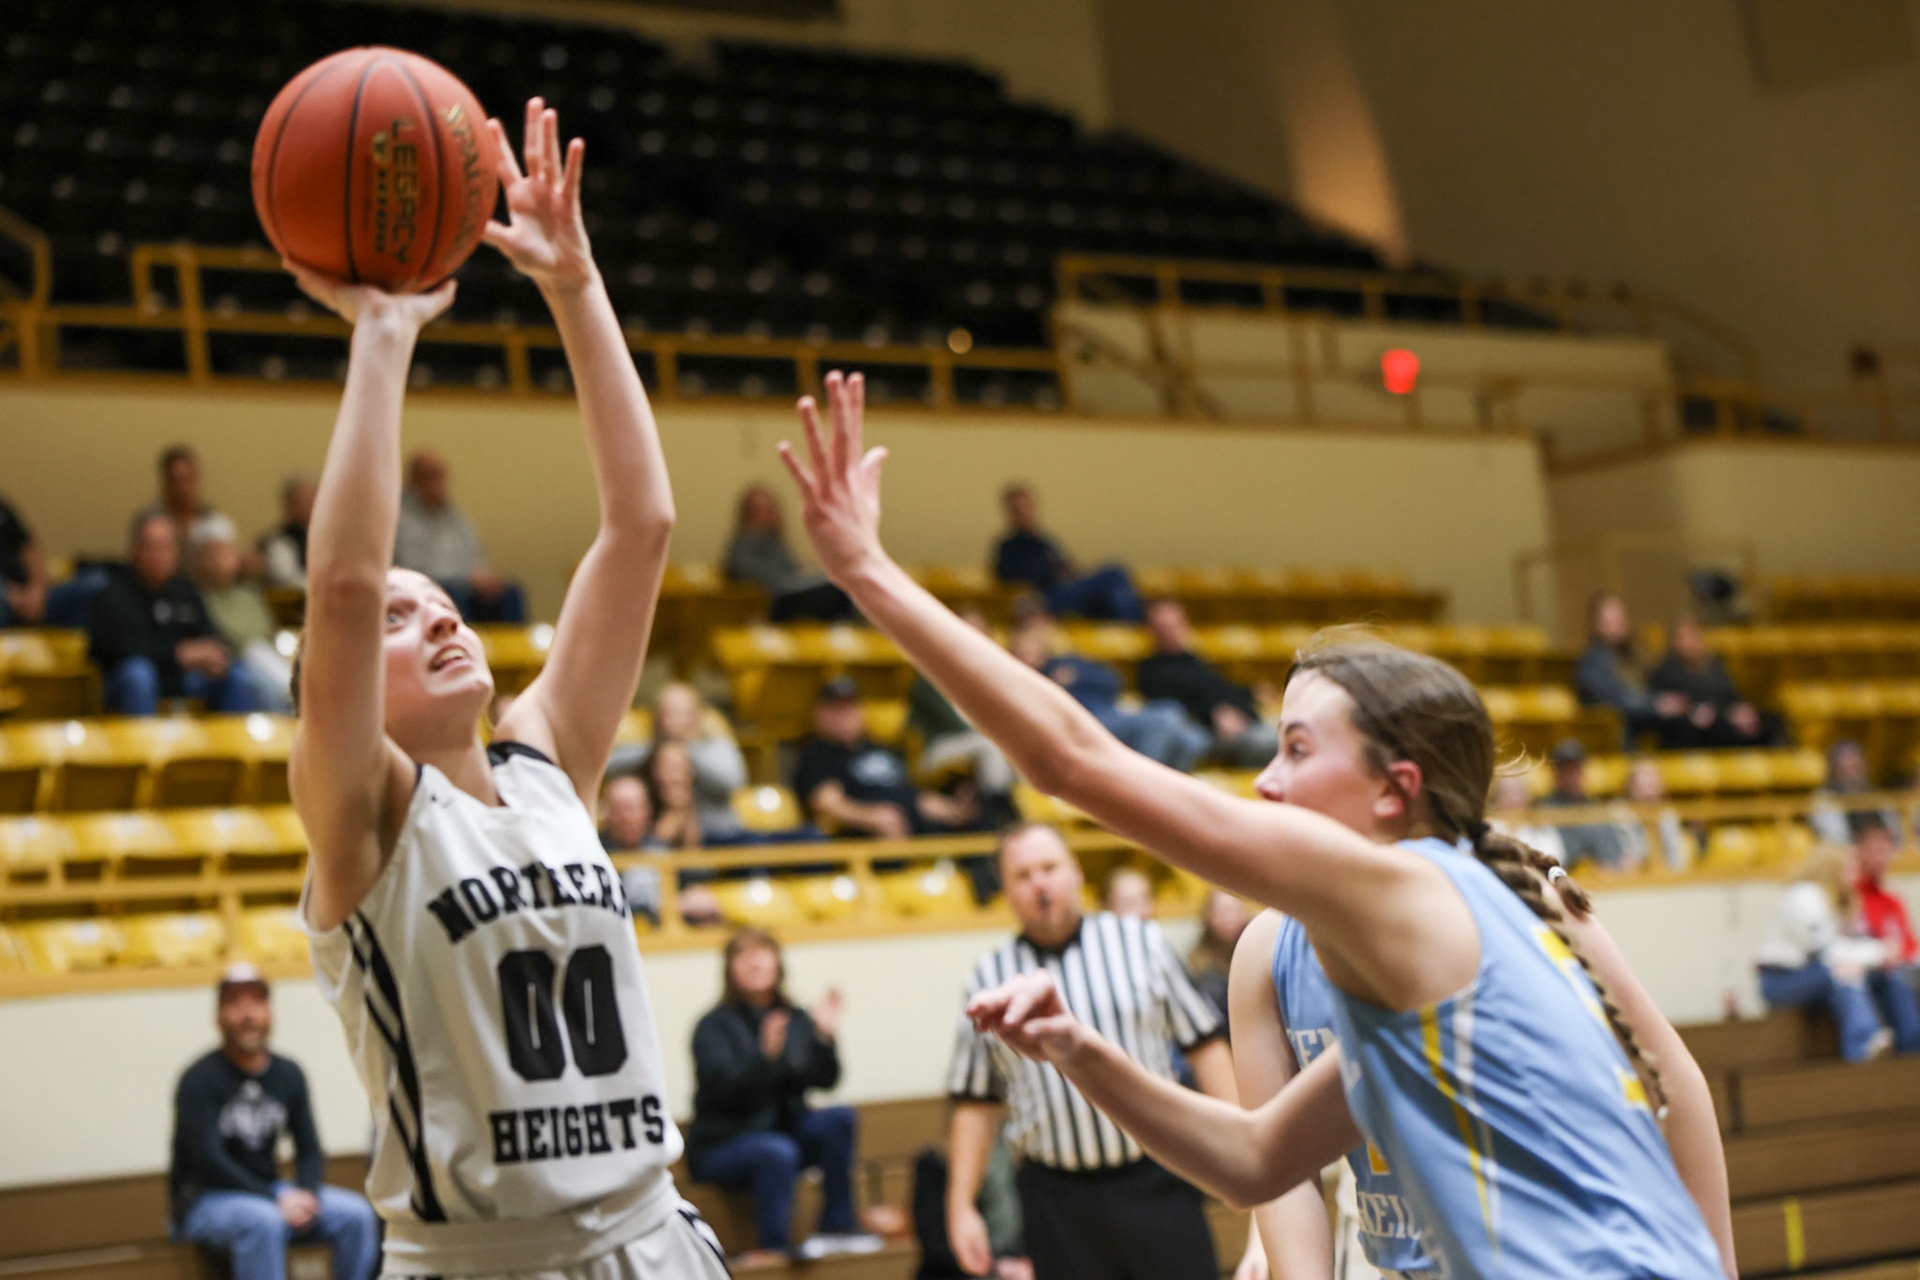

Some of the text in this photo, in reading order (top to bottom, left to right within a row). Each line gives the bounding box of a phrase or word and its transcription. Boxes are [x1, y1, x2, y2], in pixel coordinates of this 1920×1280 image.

[391, 119, 418, 264] LEGACY
[497, 944, 628, 1083] 00
[489, 1095, 664, 1165] HEIGHTS
